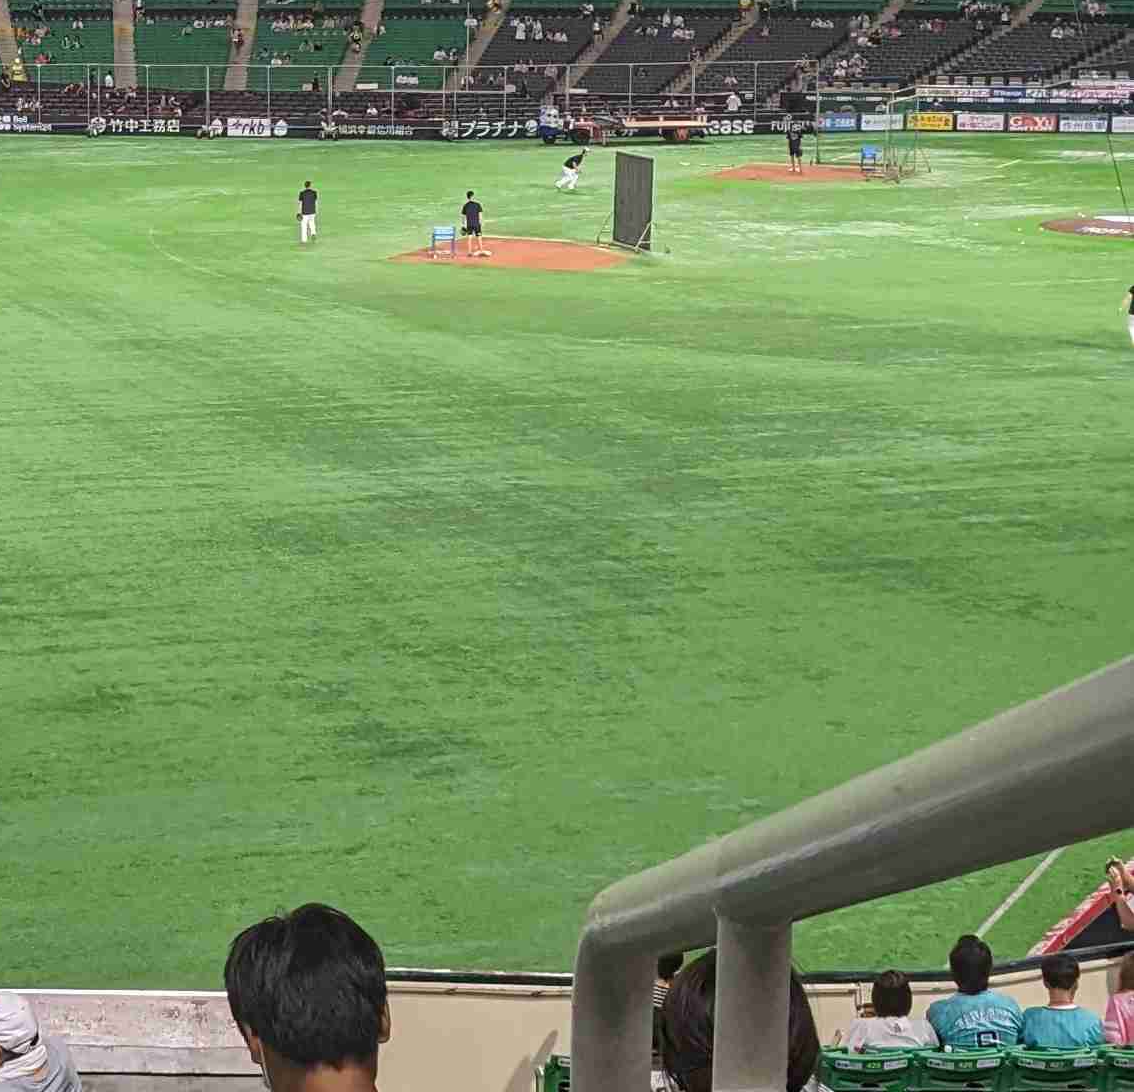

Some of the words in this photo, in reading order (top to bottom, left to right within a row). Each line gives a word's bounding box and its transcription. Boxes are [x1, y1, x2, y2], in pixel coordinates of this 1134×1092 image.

[111, 119, 180, 133] 竹中工務店
[460, 120, 523, 137] プラチナ
